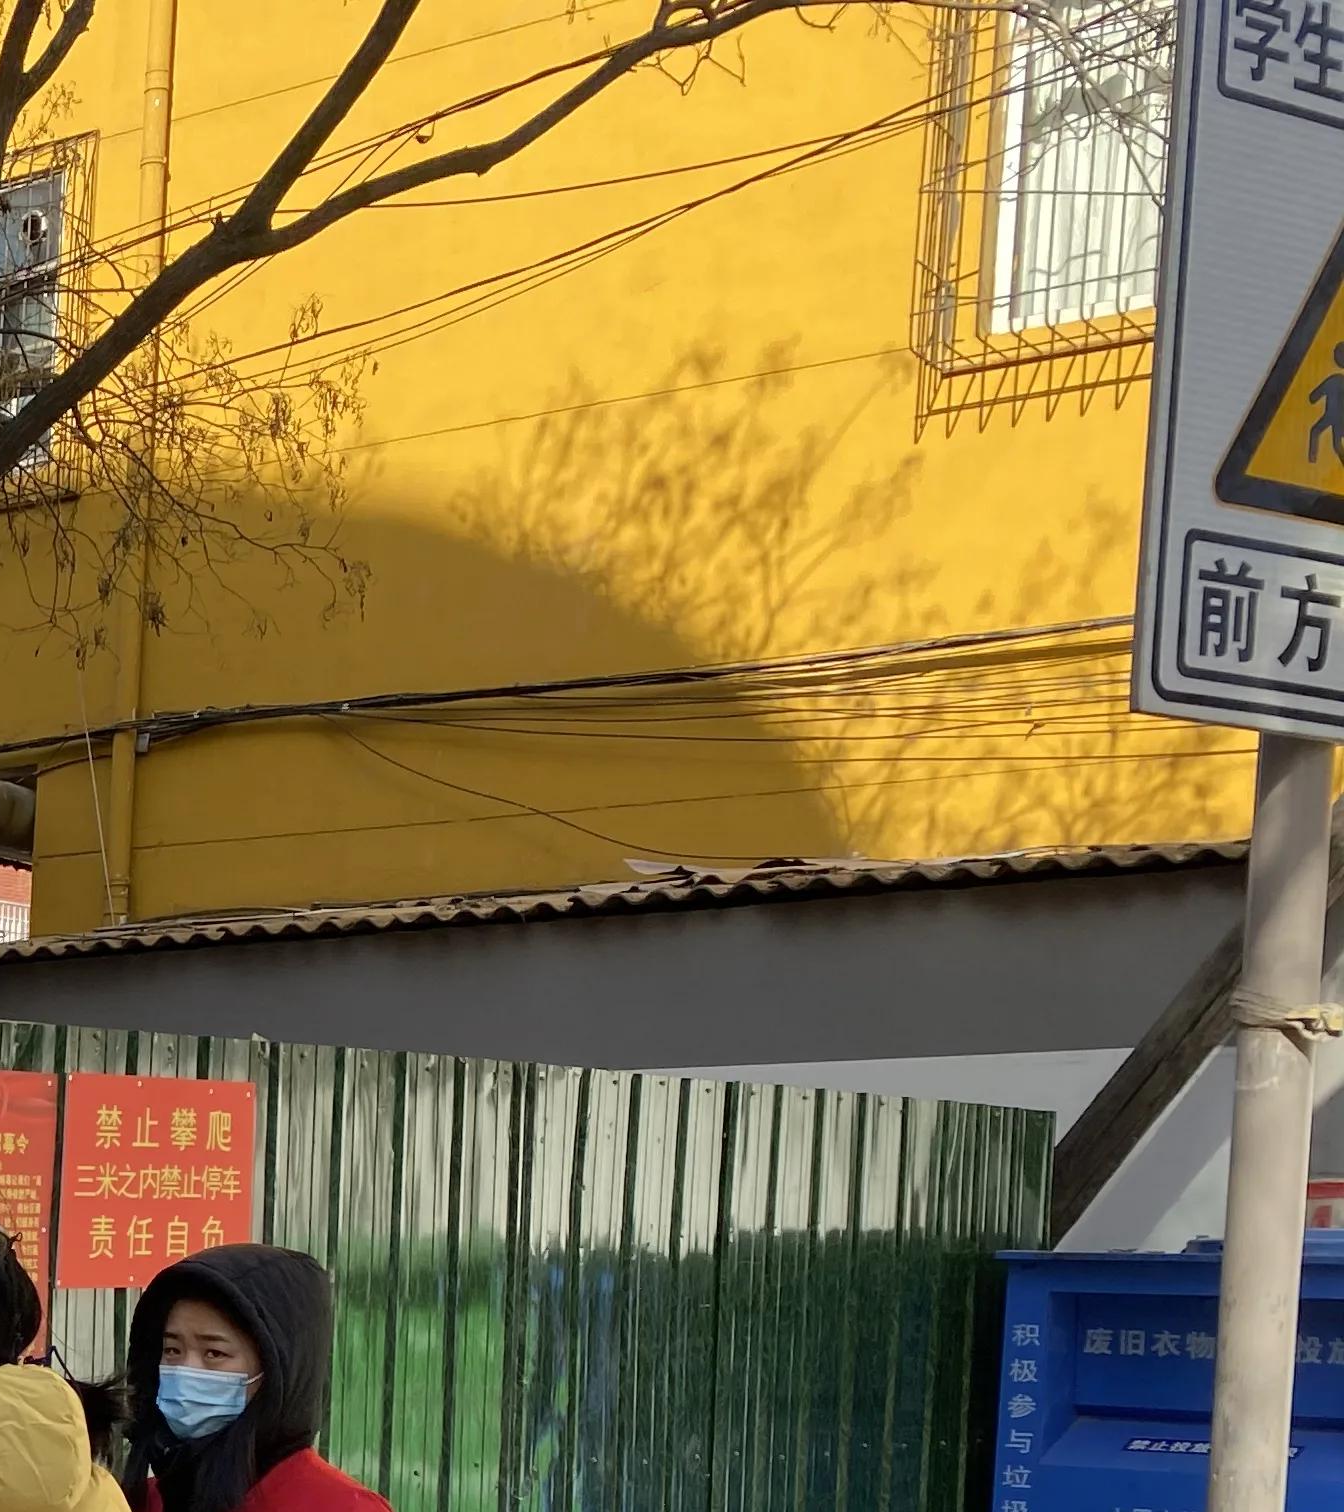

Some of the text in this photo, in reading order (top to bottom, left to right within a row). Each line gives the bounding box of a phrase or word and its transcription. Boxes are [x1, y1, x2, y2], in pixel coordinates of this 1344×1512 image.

[1234, 0, 1344, 103] 学生
[1197, 557, 1342, 673] 前方
[96, 1104, 232, 1151] 禁止攀爬
[74, 1162, 242, 1200] 三米之内禁止停车
[89, 1214, 225, 1259] 责任自负
[1083, 1328, 1216, 1360] 废旧衣物
